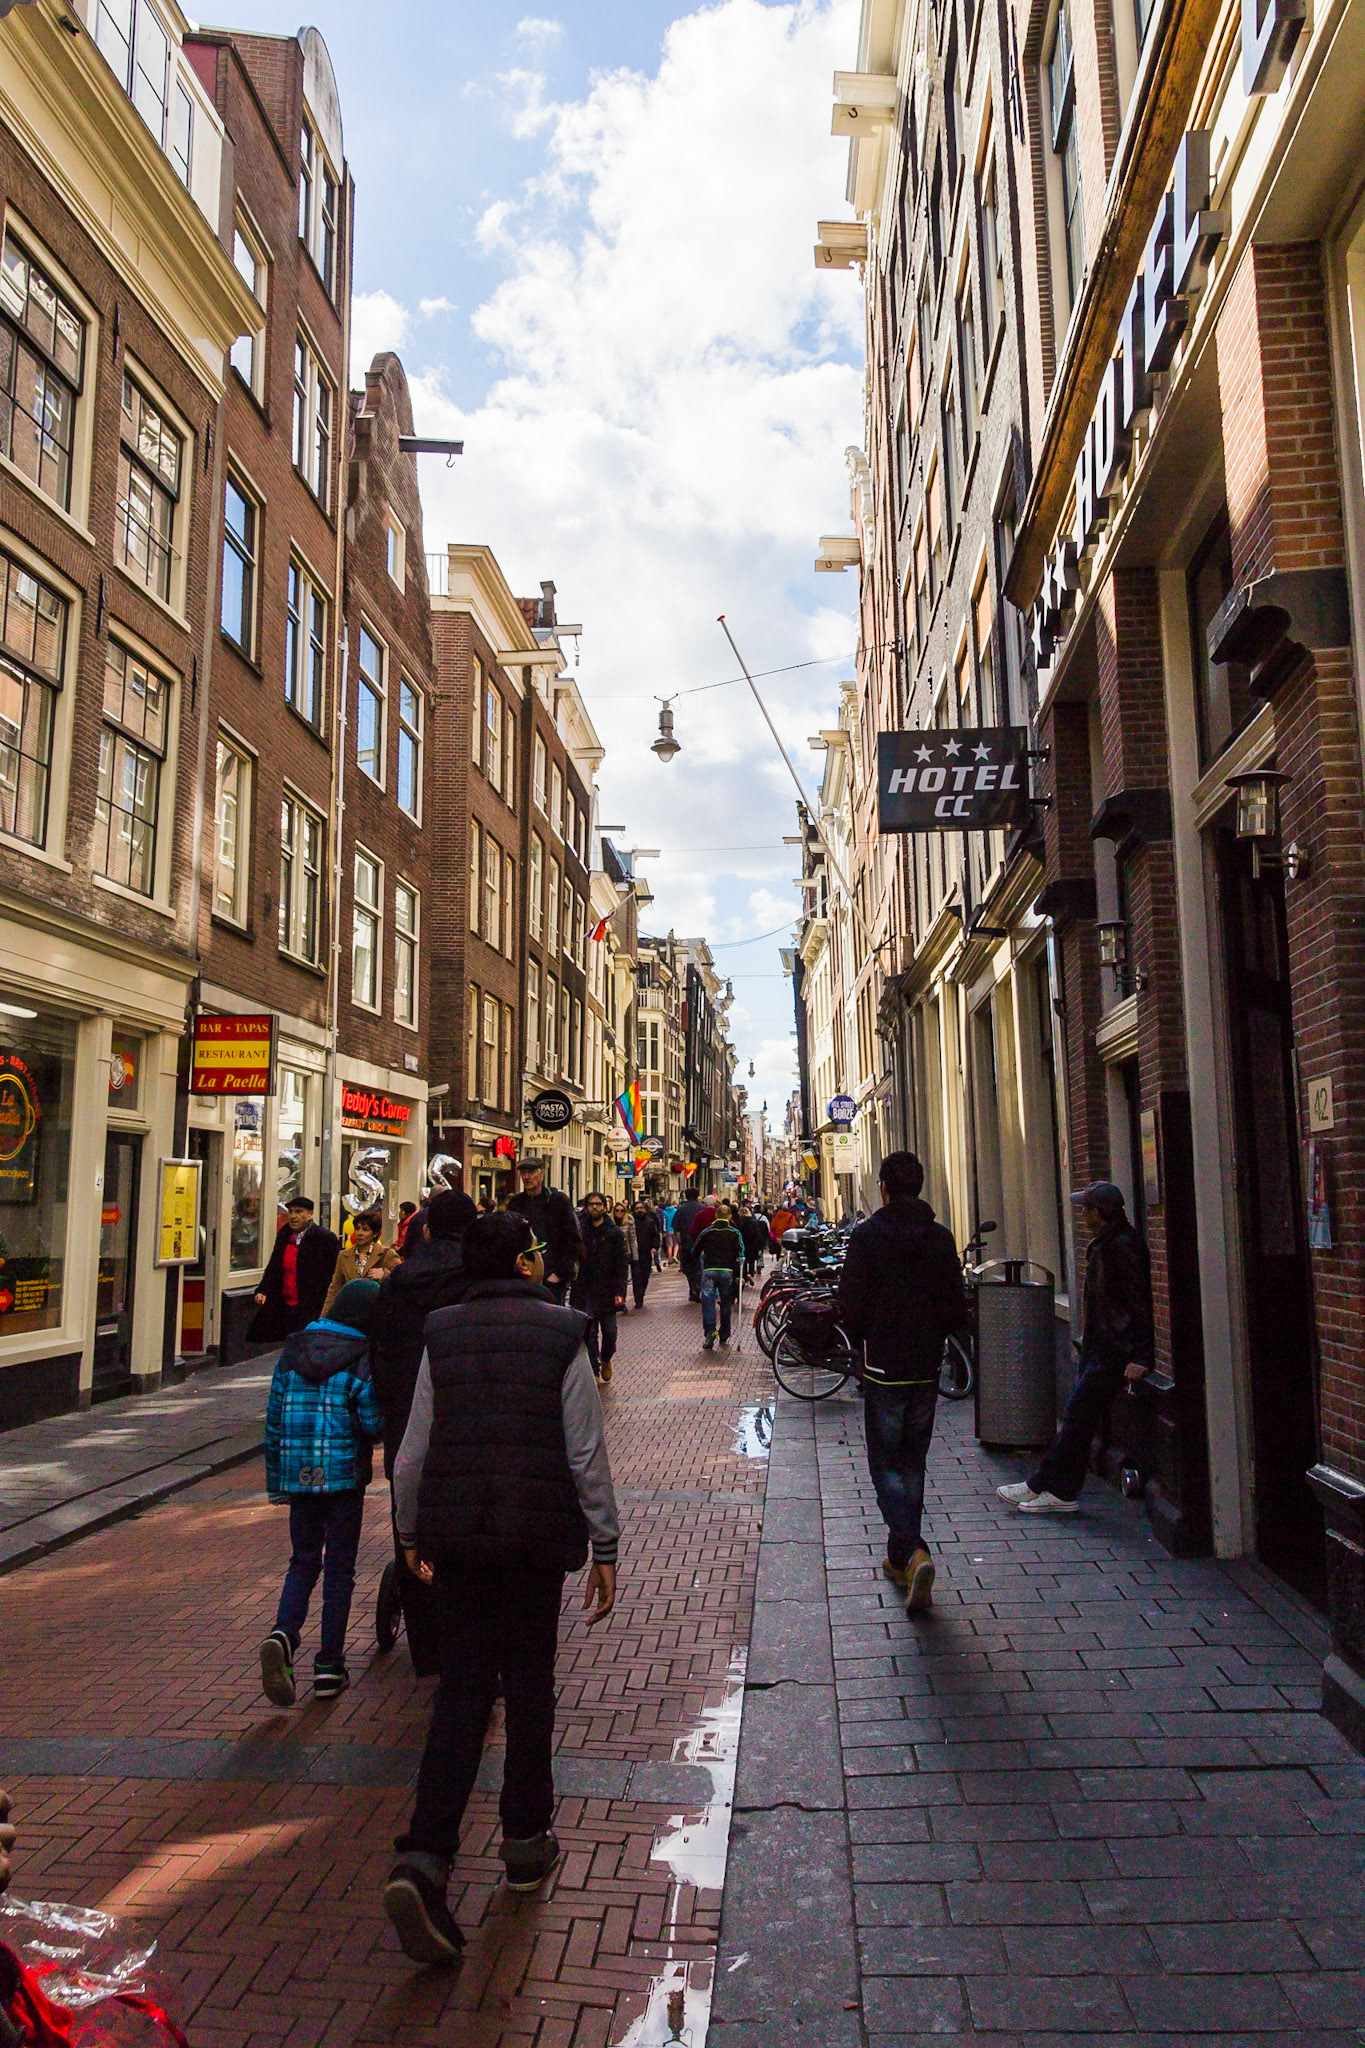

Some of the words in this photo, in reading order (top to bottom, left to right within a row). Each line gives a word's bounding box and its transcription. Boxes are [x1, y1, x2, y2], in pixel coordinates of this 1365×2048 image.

[1075, 129, 1205, 558] HOTEL
[888, 764, 1020, 794] HOTEL
[934, 794, 974, 818] CC
[200, 1023, 222, 1033] BAR
[235, 1023, 269, 1033] TAPAS
[199, 1050, 267, 1059] RESTAURANT
[197, 1073, 217, 1088] La
[222, 1073, 267, 1088] Paella
[342, 1086, 379, 1119] Teddy's
[381, 1096, 411, 1121] Corner
[540, 1103, 565, 1111] PASTA
[1314, 1087, 1329, 1121] 42
[832, 1107, 855, 1120] BOOZE
[529, 1133, 554, 1143] BABA
[299, 1465, 325, 1486] 62
